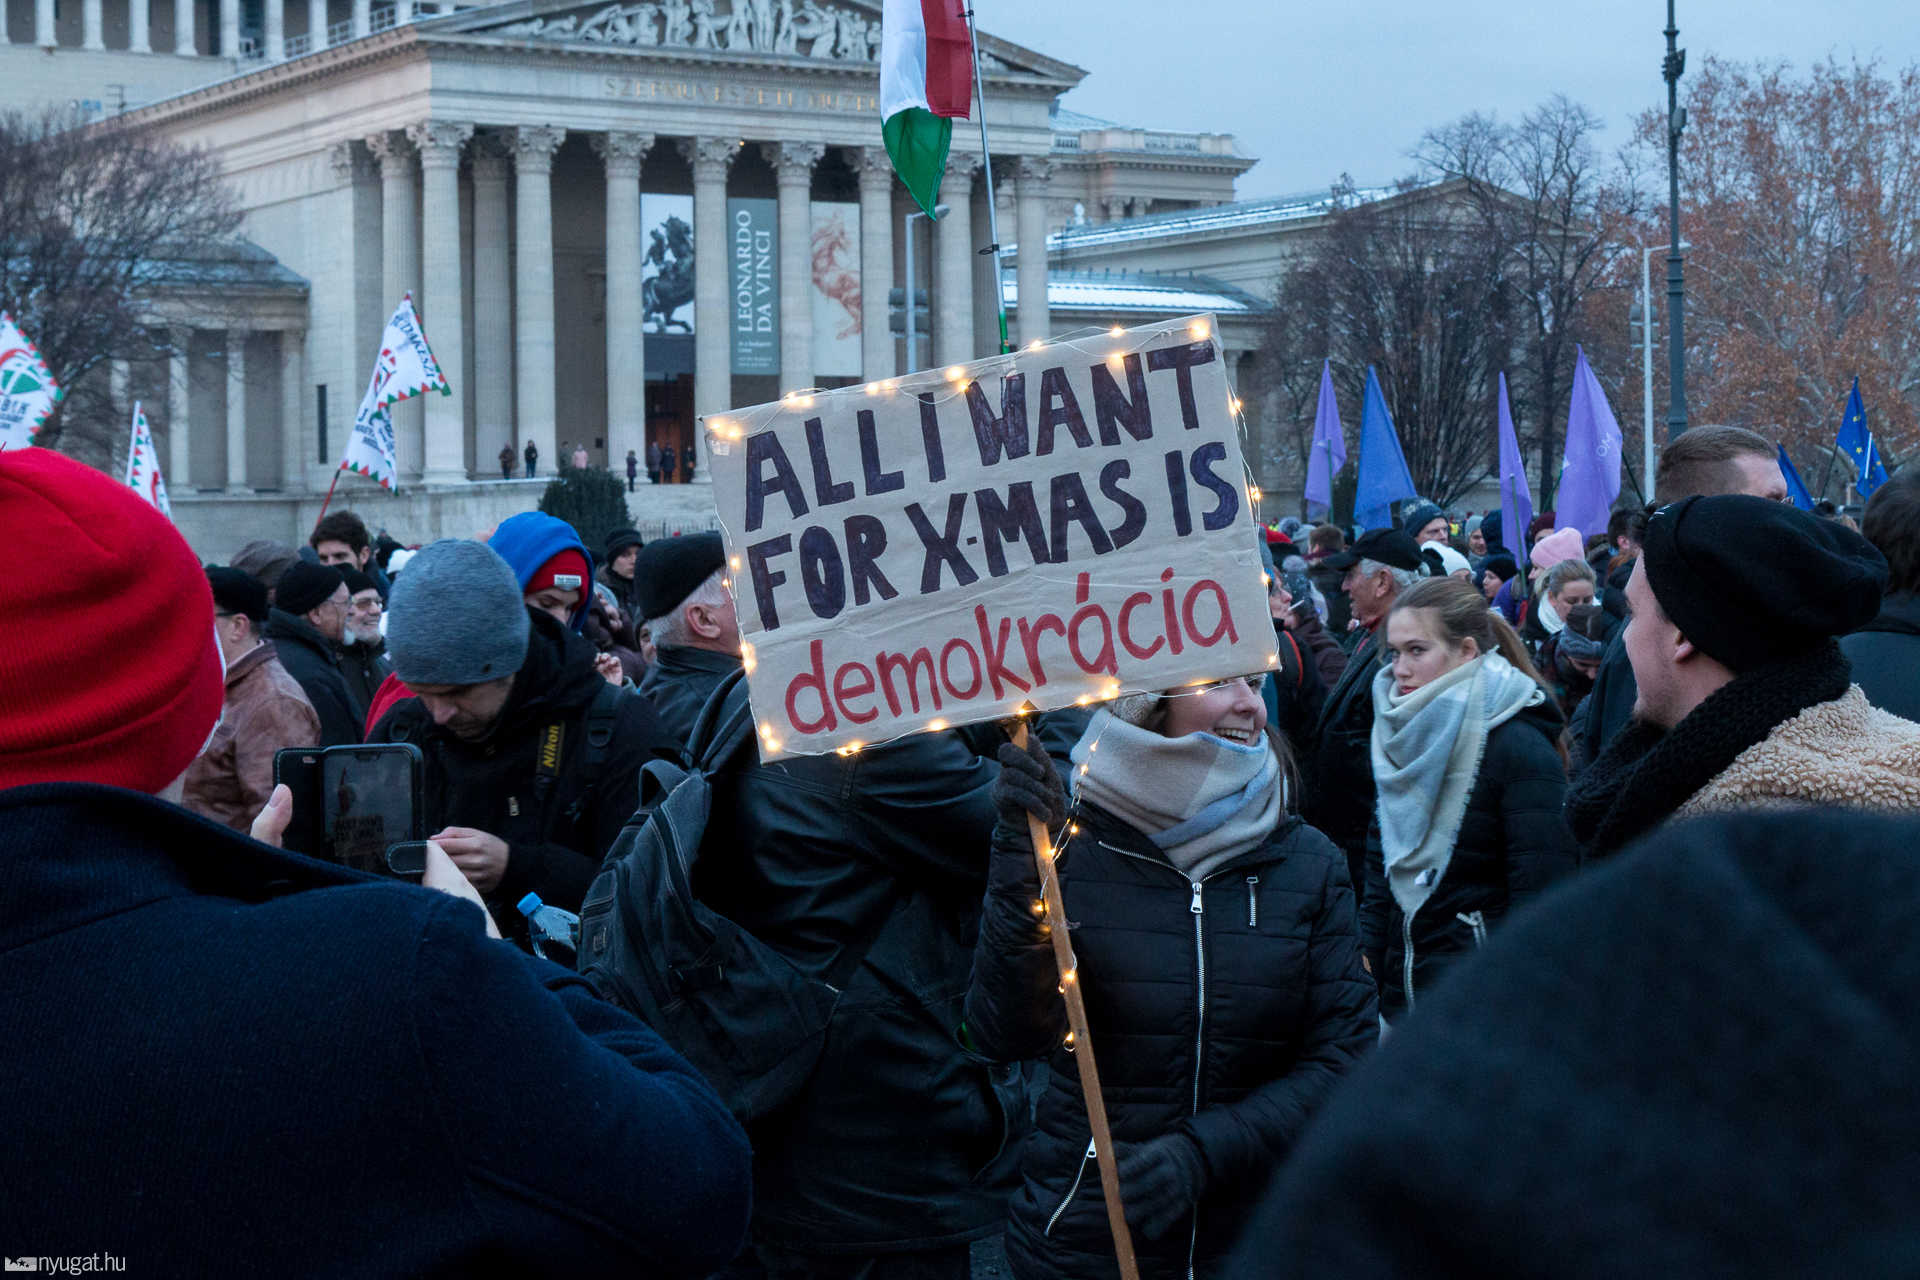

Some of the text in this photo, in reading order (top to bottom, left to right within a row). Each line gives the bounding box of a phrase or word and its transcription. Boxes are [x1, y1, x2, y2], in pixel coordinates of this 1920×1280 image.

[737, 211, 753, 332] LEONARDO
[755, 230, 772, 332] DA VINCI
[745, 340, 1215, 532] ALL I WANT
[746, 441, 1239, 631] FOR X-MAS IS
[784, 566, 1239, 735] demokrácia
[543, 725, 561, 768] Nikon
